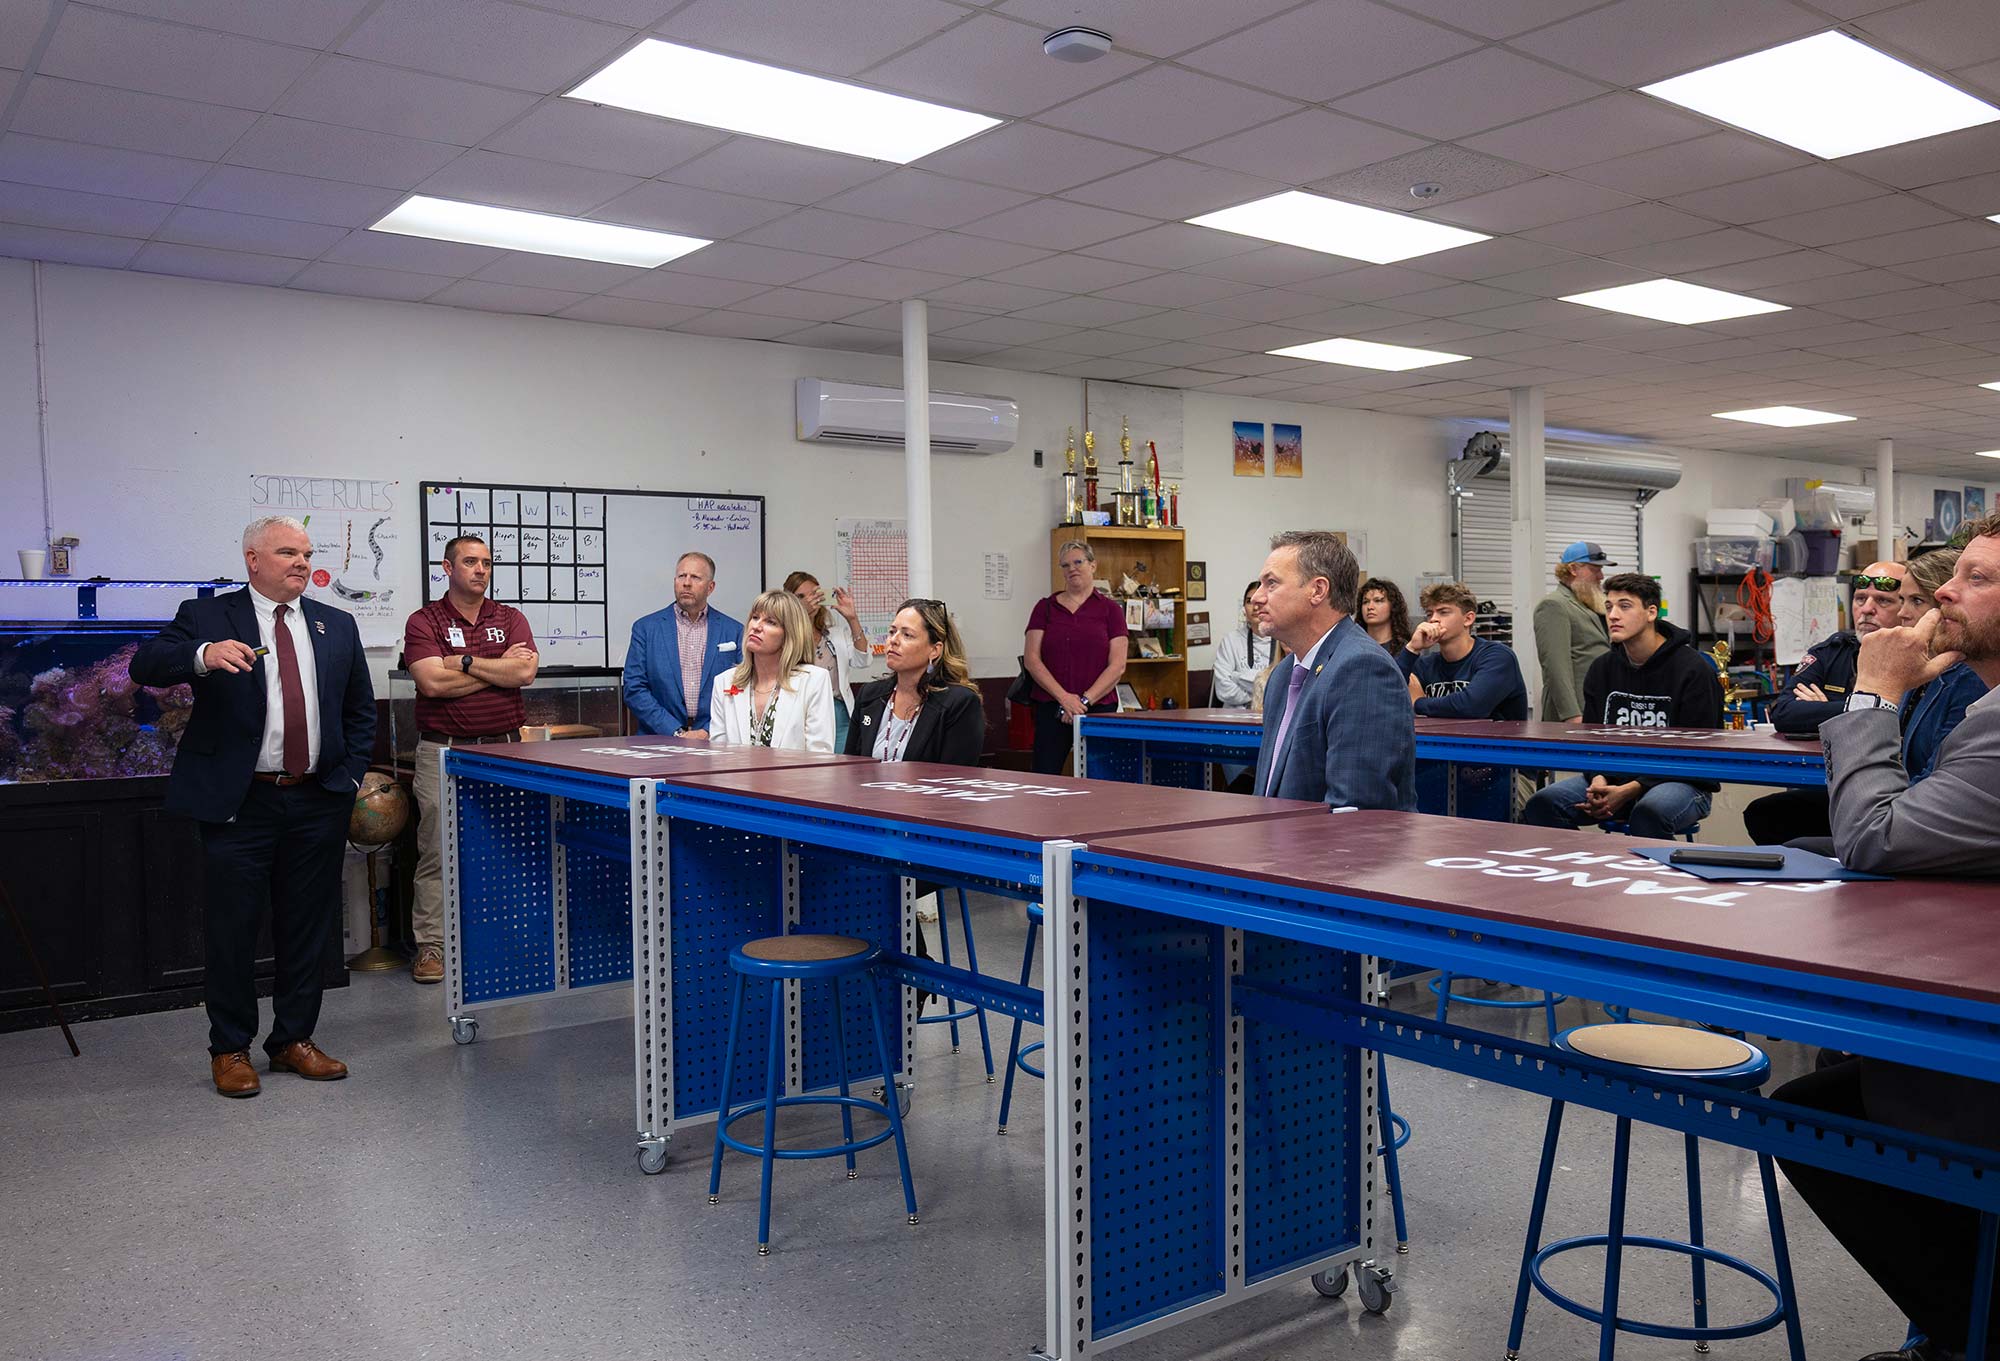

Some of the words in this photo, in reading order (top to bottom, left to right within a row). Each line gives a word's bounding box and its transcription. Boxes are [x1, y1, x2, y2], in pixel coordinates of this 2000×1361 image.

[252, 475, 323, 508] SNAKE
[332, 479, 393, 512] RULES
[464, 501, 476, 515] M
[499, 501, 511, 515] T
[525, 505, 538, 516] W
[554, 505, 568, 517] Th
[583, 506, 592, 519] F
[433, 532, 448, 542] This
[522, 588, 530, 597] 5
[551, 588, 557, 597] 6
[578, 590, 587, 599] 7
[1616, 707, 1667, 727] 2026
[860, 781, 1015, 802] TANGO
[917, 777, 1092, 797] FLIGHT
[1425, 857, 1749, 907] TANGO
